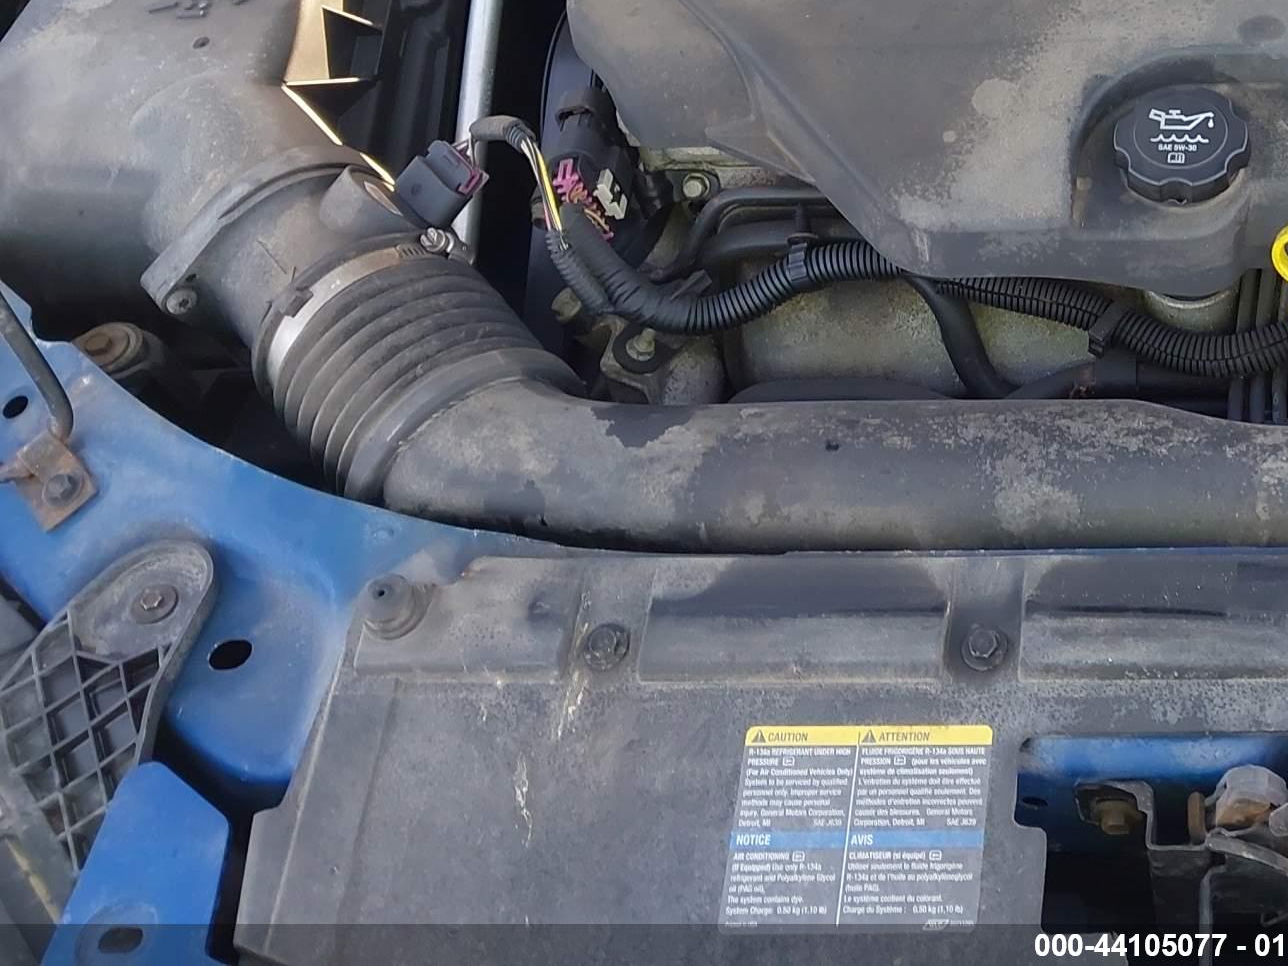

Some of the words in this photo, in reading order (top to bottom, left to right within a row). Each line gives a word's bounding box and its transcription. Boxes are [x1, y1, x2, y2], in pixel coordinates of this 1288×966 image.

[768, 733, 808, 742] CAUTION
[879, 732, 930, 742] ATTENTION
[772, 748, 812, 756] REFRIGERANT
[748, 758, 778, 766] PRESSURE
[912, 758, 928, 766] (pour
[837, 768, 853, 776] Only)
[745, 779, 767, 787] System
[776, 778, 784, 786] be
[786, 778, 811, 786] serviced
[813, 778, 819, 786] by
[821, 778, 848, 786] qualified
[743, 789, 773, 797] personnel
[790, 788, 817, 797] Improper
[857, 789, 868, 797] par
[878, 788, 908, 797] personnel
[803, 798, 830, 807] personal
[958, 799, 982, 807] peuvent
[763, 819, 770, 827] MI
[736, 834, 771, 845] NOTICE
[851, 834, 874, 846] AVIS
[733, 852, 744, 860] AIR
[746, 852, 789, 860] CONDITIONING
[849, 851, 892, 860] CLIMATISEUR
[740, 863, 770, 872] Equipped)
[772, 863, 783, 871] Use
[785, 863, 798, 872] only
[800, 863, 821, 871] R-134a
[848, 863, 869, 871] Utiliser
[911, 862, 928, 870] fluide
[730, 874, 762, 883] refrigerant
[777, 873, 815, 883] Polyalkylene
[817, 873, 835, 883] Glycol
[878, 873, 886, 881] de
[740, 896, 762, 904] system
[726, 907, 748, 915] System
[793, 906, 800, 915] kg
[843, 906, 865, 915] Charge
[928, 905, 936, 915] kg
